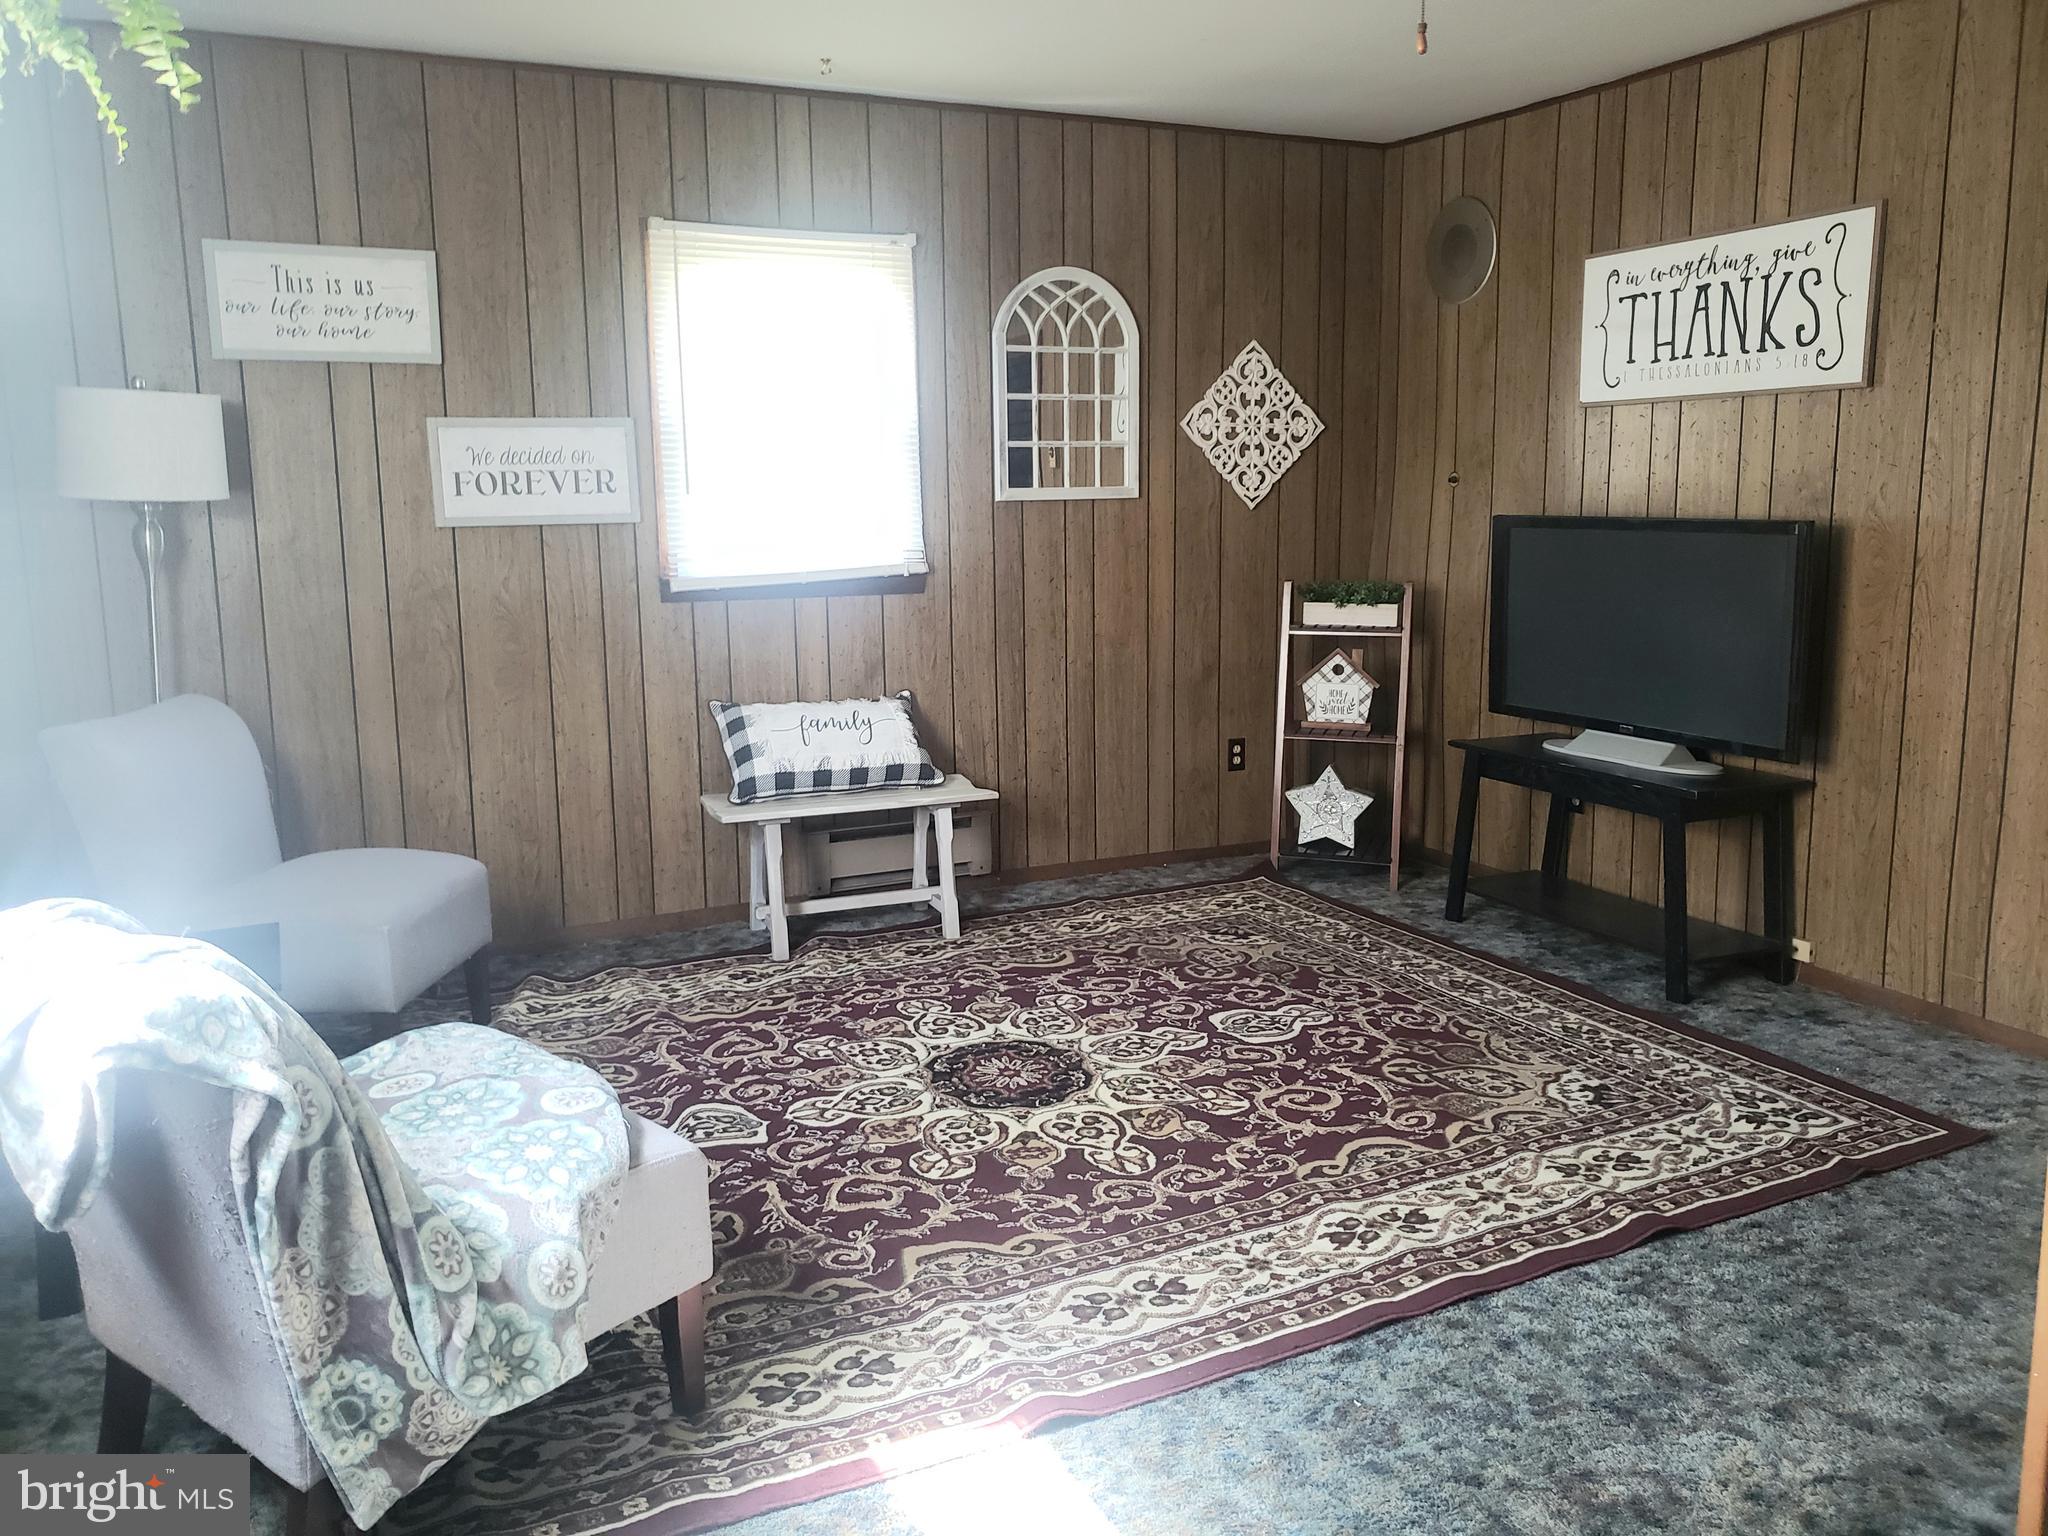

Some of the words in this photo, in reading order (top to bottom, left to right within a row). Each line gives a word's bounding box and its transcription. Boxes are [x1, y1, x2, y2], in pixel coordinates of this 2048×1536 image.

[1625, 271, 1646, 287] in
[1771, 240, 1816, 272] give
[270, 263, 314, 294] This
[325, 271, 342, 296] is
[354, 279, 375, 297] us
[225, 299, 261, 315] our
[324, 303, 357, 317] our
[1618, 267, 1822, 364] THANKS
[275, 322, 311, 338] our
[318, 320, 376, 340] home
[1639, 356, 1762, 382] THESSALONIANS
[465, 446, 495, 466] We
[499, 444, 567, 466] decided
[570, 449, 595, 465] on
[451, 468, 617, 498] FOREVER
[796, 709, 877, 747] family
